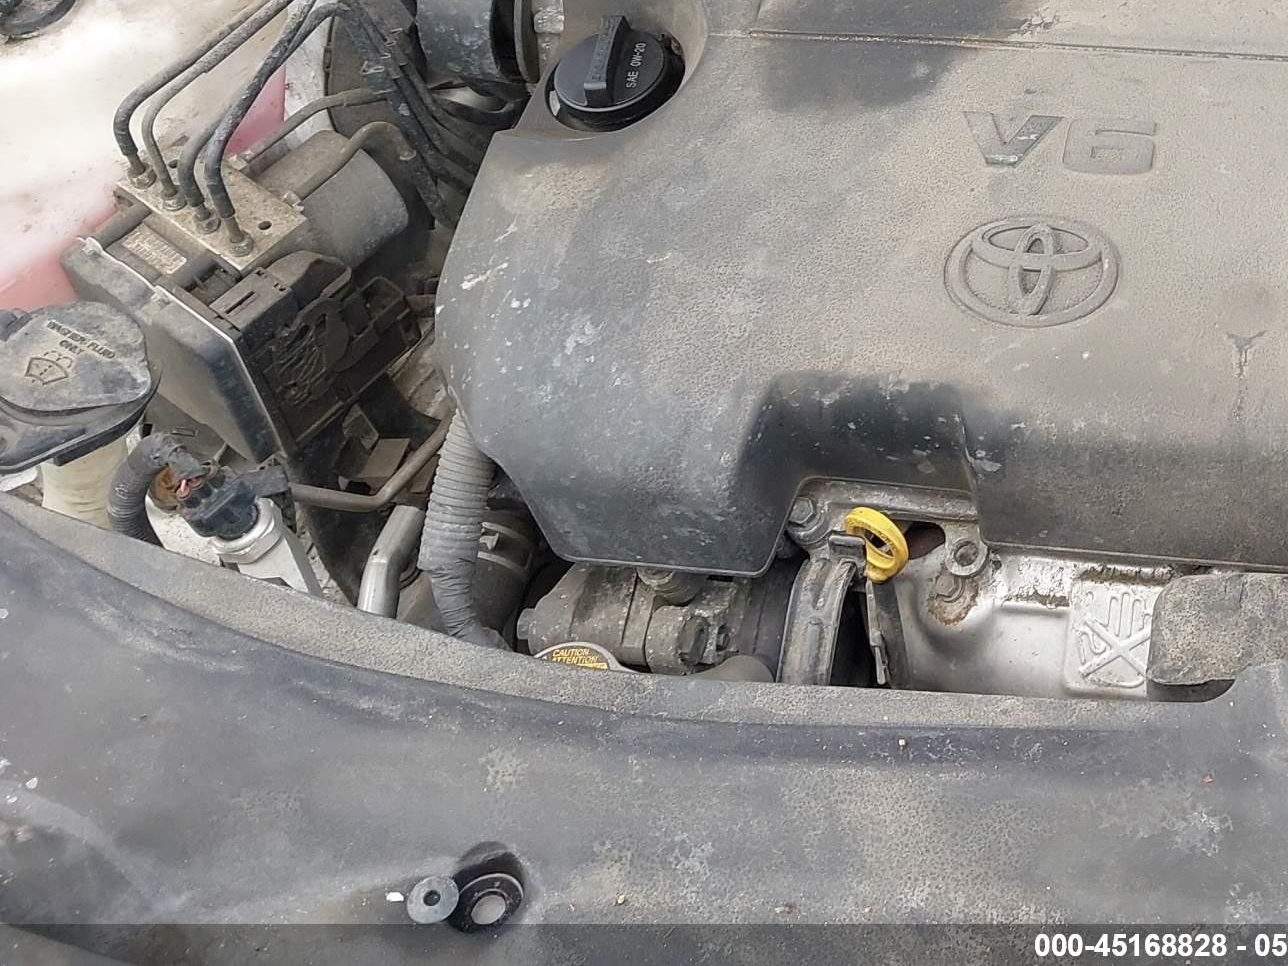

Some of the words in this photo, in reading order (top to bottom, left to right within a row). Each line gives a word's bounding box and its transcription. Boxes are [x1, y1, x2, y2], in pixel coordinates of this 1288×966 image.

[630, 42, 647, 67] 0W-20
[625, 71, 639, 88] SAE
[961, 109, 1157, 176] V6
[46, 320, 86, 342] WASHER
[87, 340, 116, 359] FLUID
[59, 339, 85, 355] ONLY
[552, 648, 590, 657] CAUTION
[552, 655, 598, 664] ATTENTION
